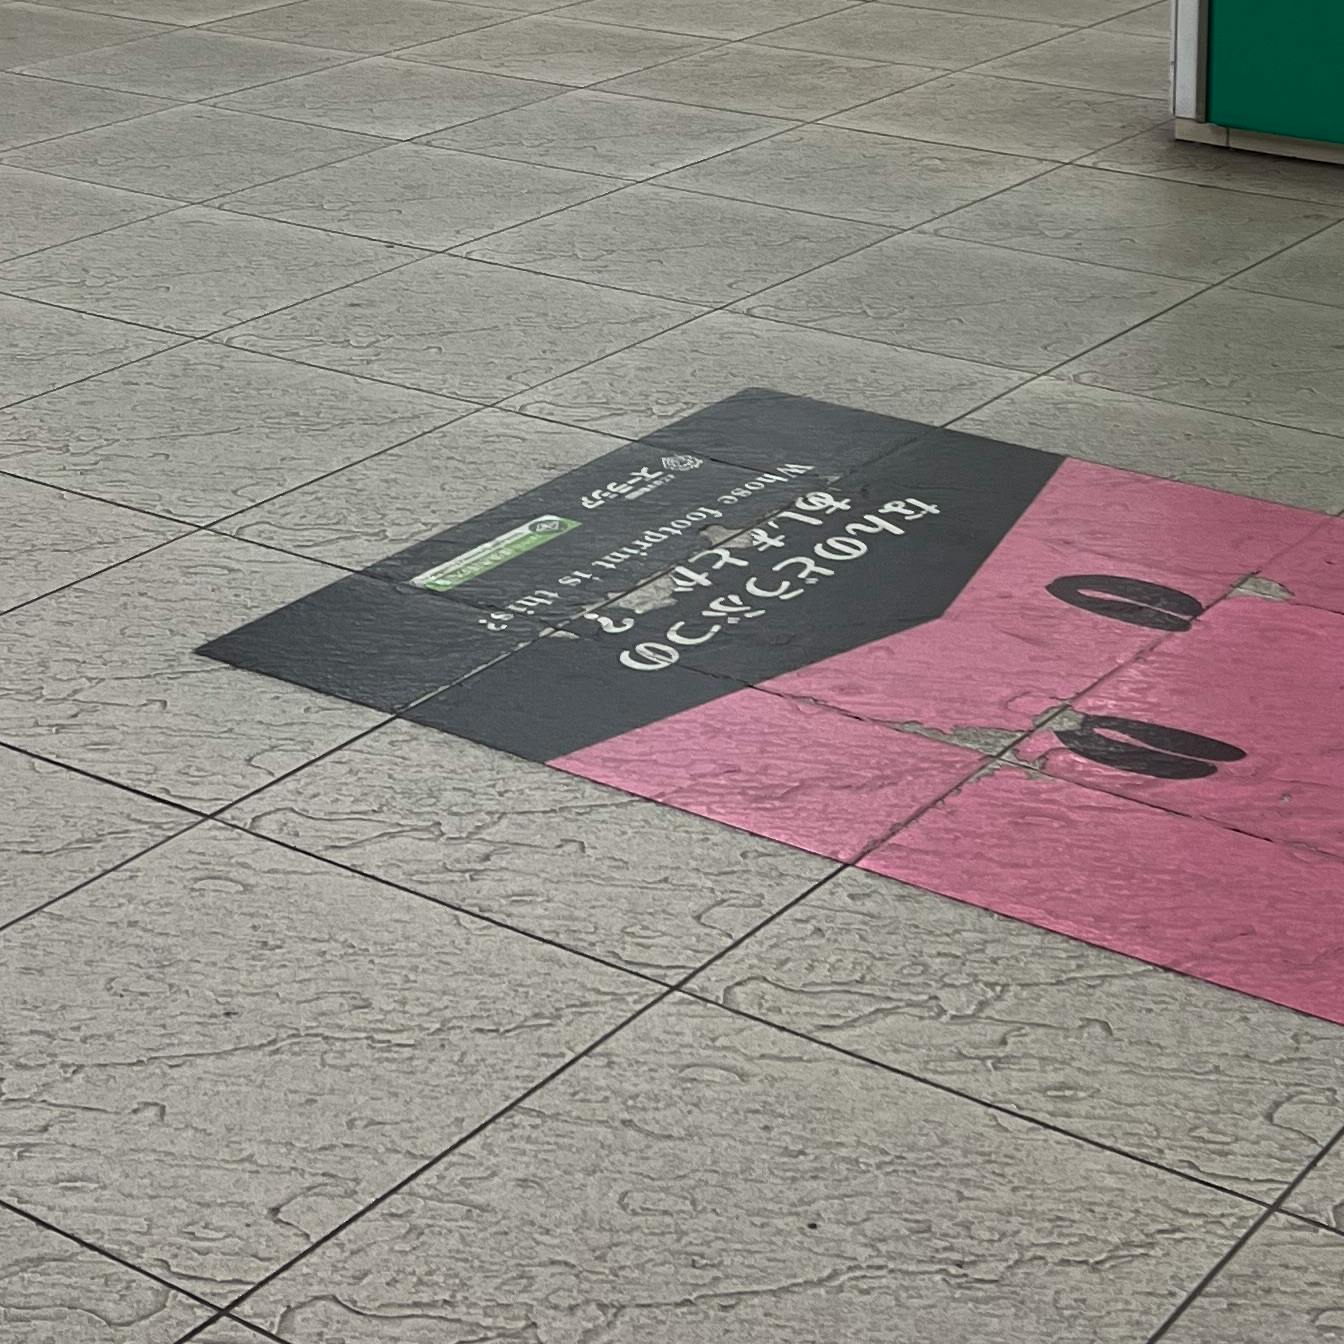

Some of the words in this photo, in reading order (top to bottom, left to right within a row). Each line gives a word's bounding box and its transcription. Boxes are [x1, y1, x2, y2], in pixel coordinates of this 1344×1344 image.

[717, 463, 815, 504] Whose
[584, 491, 851, 633] あしあとか?
[592, 507, 723, 568] footprint
[558, 570, 602, 586] is
[619, 497, 940, 671] なんのどうぶつの
[479, 589, 559, 631] this?
